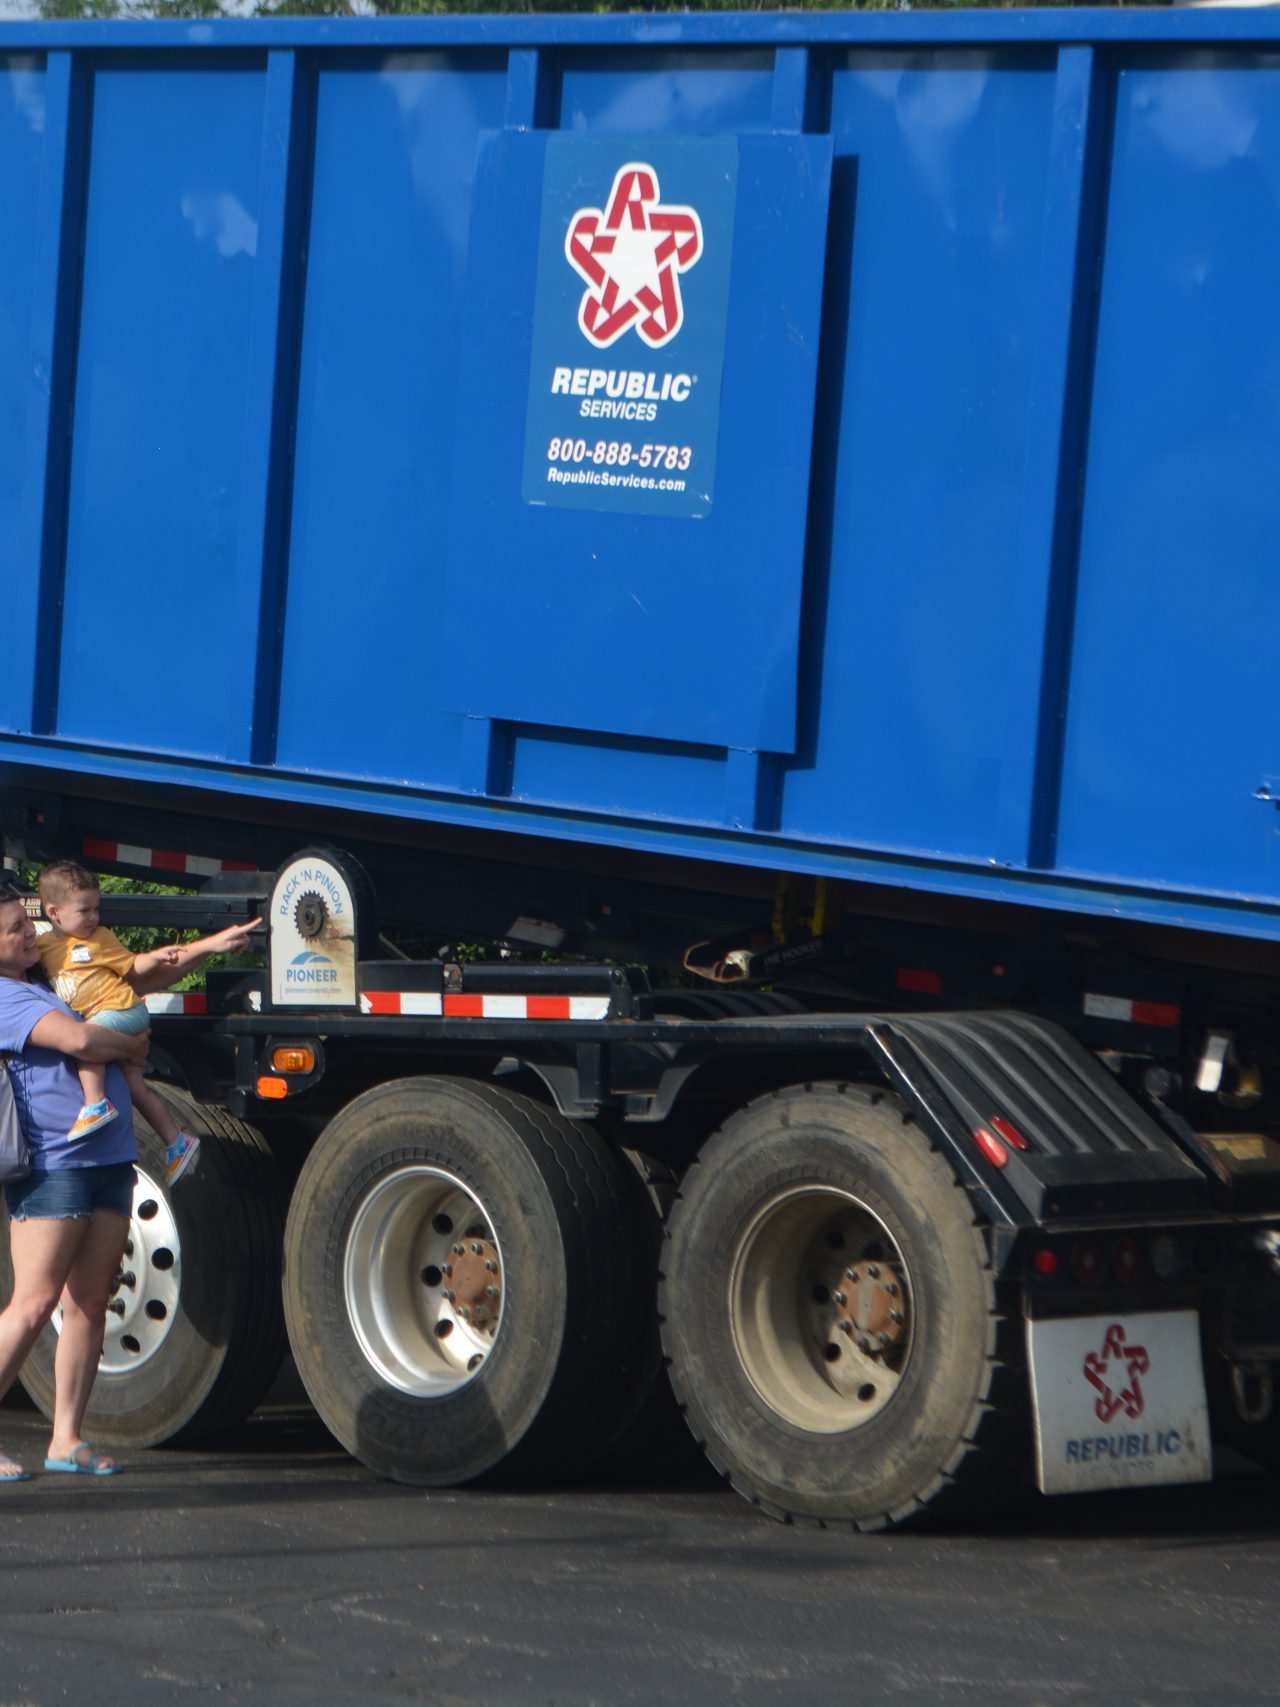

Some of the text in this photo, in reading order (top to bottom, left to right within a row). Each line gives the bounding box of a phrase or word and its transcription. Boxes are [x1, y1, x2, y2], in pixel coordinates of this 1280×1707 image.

[551, 367, 692, 402] REPUBLIC
[579, 399, 658, 421] SERVICES
[547, 438, 692, 470] 800-888-5783
[547, 467, 686, 491] RepublicServices.com
[280, 875, 300, 916] RACK
[315, 870, 343, 914] PINION
[286, 968, 337, 983] PIONEER
[1066, 1430, 1182, 1464] REPUBLIC
